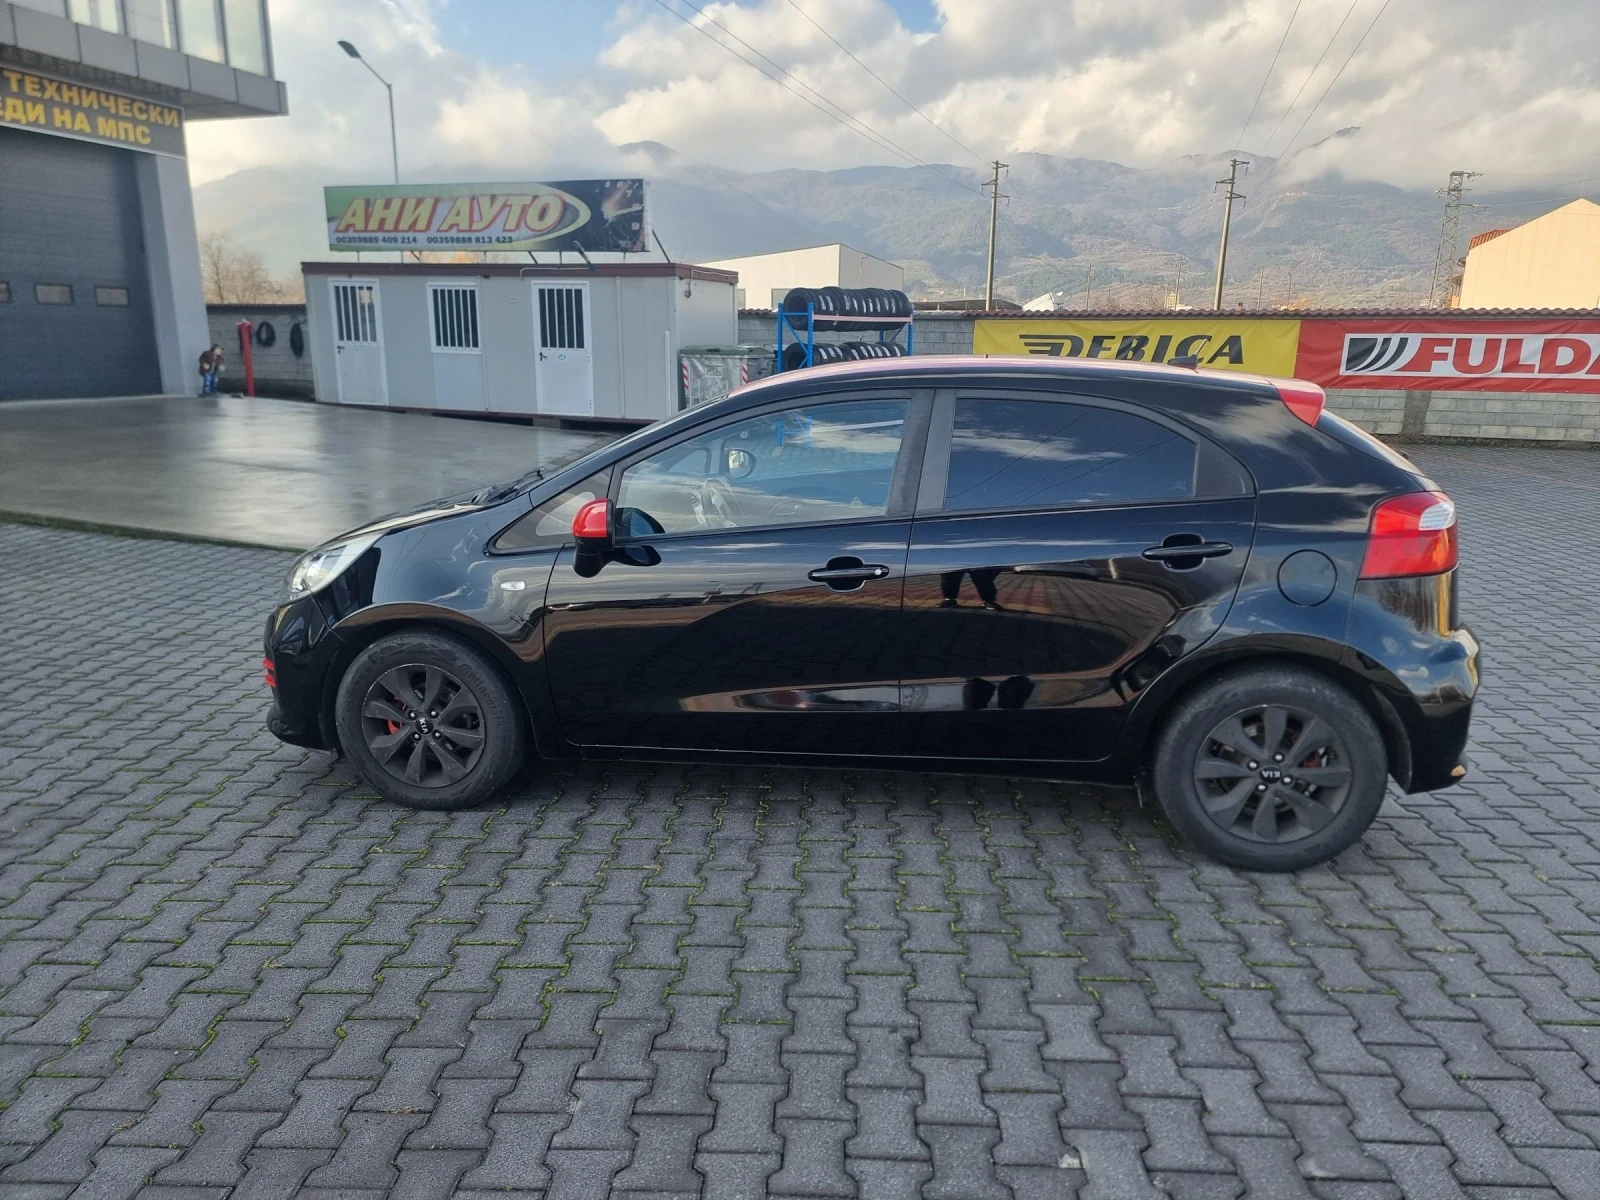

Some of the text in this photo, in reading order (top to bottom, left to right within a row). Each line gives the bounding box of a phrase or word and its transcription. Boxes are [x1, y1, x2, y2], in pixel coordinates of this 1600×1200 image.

[3, 70, 179, 128] ТЕХНИЧЕСКИ
[0, 97, 152, 145] ДИ НА МПС
[336, 194, 565, 233] АНИ АУТО
[400, 236, 417, 245] 214
[495, 236, 513, 245] 423
[1261, 770, 1281, 778] KIA
